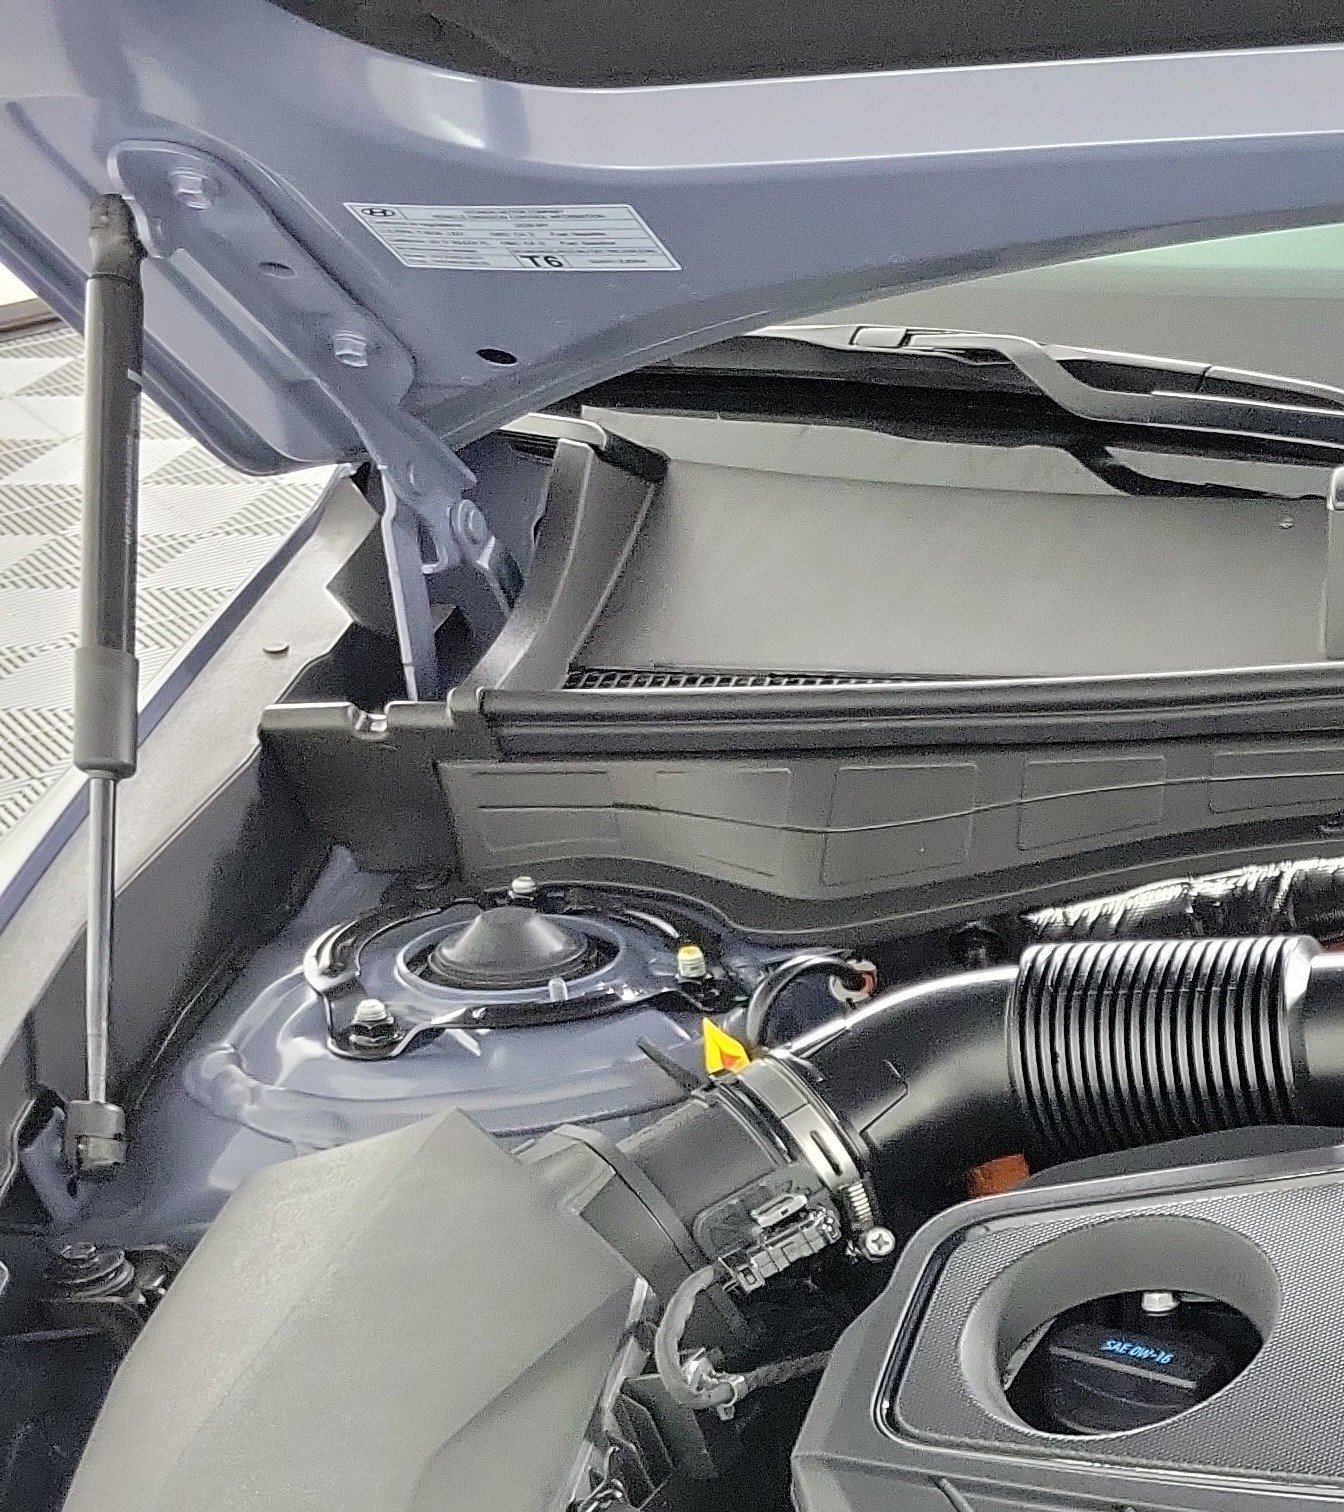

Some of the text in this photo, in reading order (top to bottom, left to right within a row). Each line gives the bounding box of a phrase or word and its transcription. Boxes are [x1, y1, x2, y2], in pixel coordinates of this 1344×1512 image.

[520, 255, 564, 268] T6
[1099, 1340, 1175, 1364] SAE 0W-16
